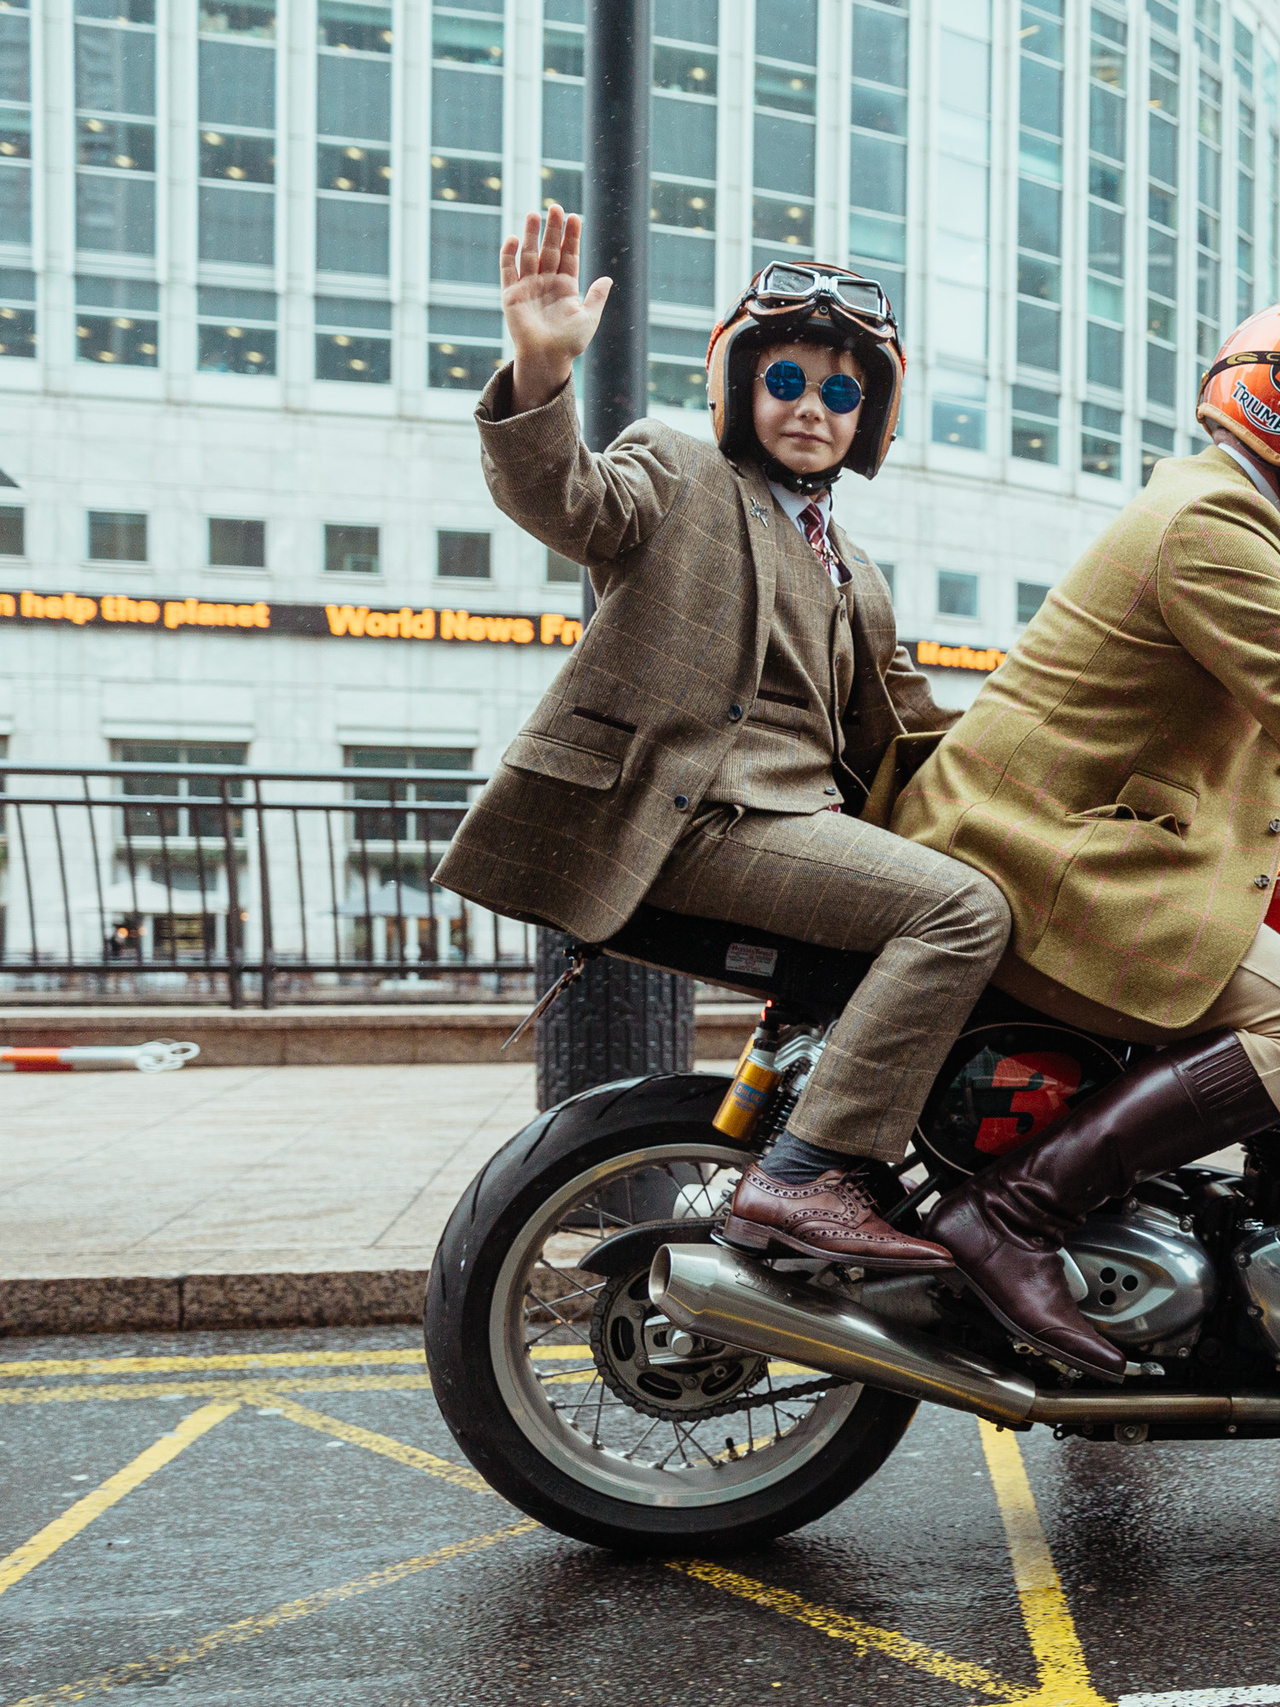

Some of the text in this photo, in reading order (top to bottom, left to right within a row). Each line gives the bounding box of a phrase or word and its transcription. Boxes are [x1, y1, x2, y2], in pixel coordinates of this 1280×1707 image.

[20, 590, 98, 624] help
[101, 595, 161, 622] the
[163, 598, 271, 629] planet
[325, 604, 435, 639] World
[440, 609, 534, 643] News
[974, 1052, 1082, 1156] 3
